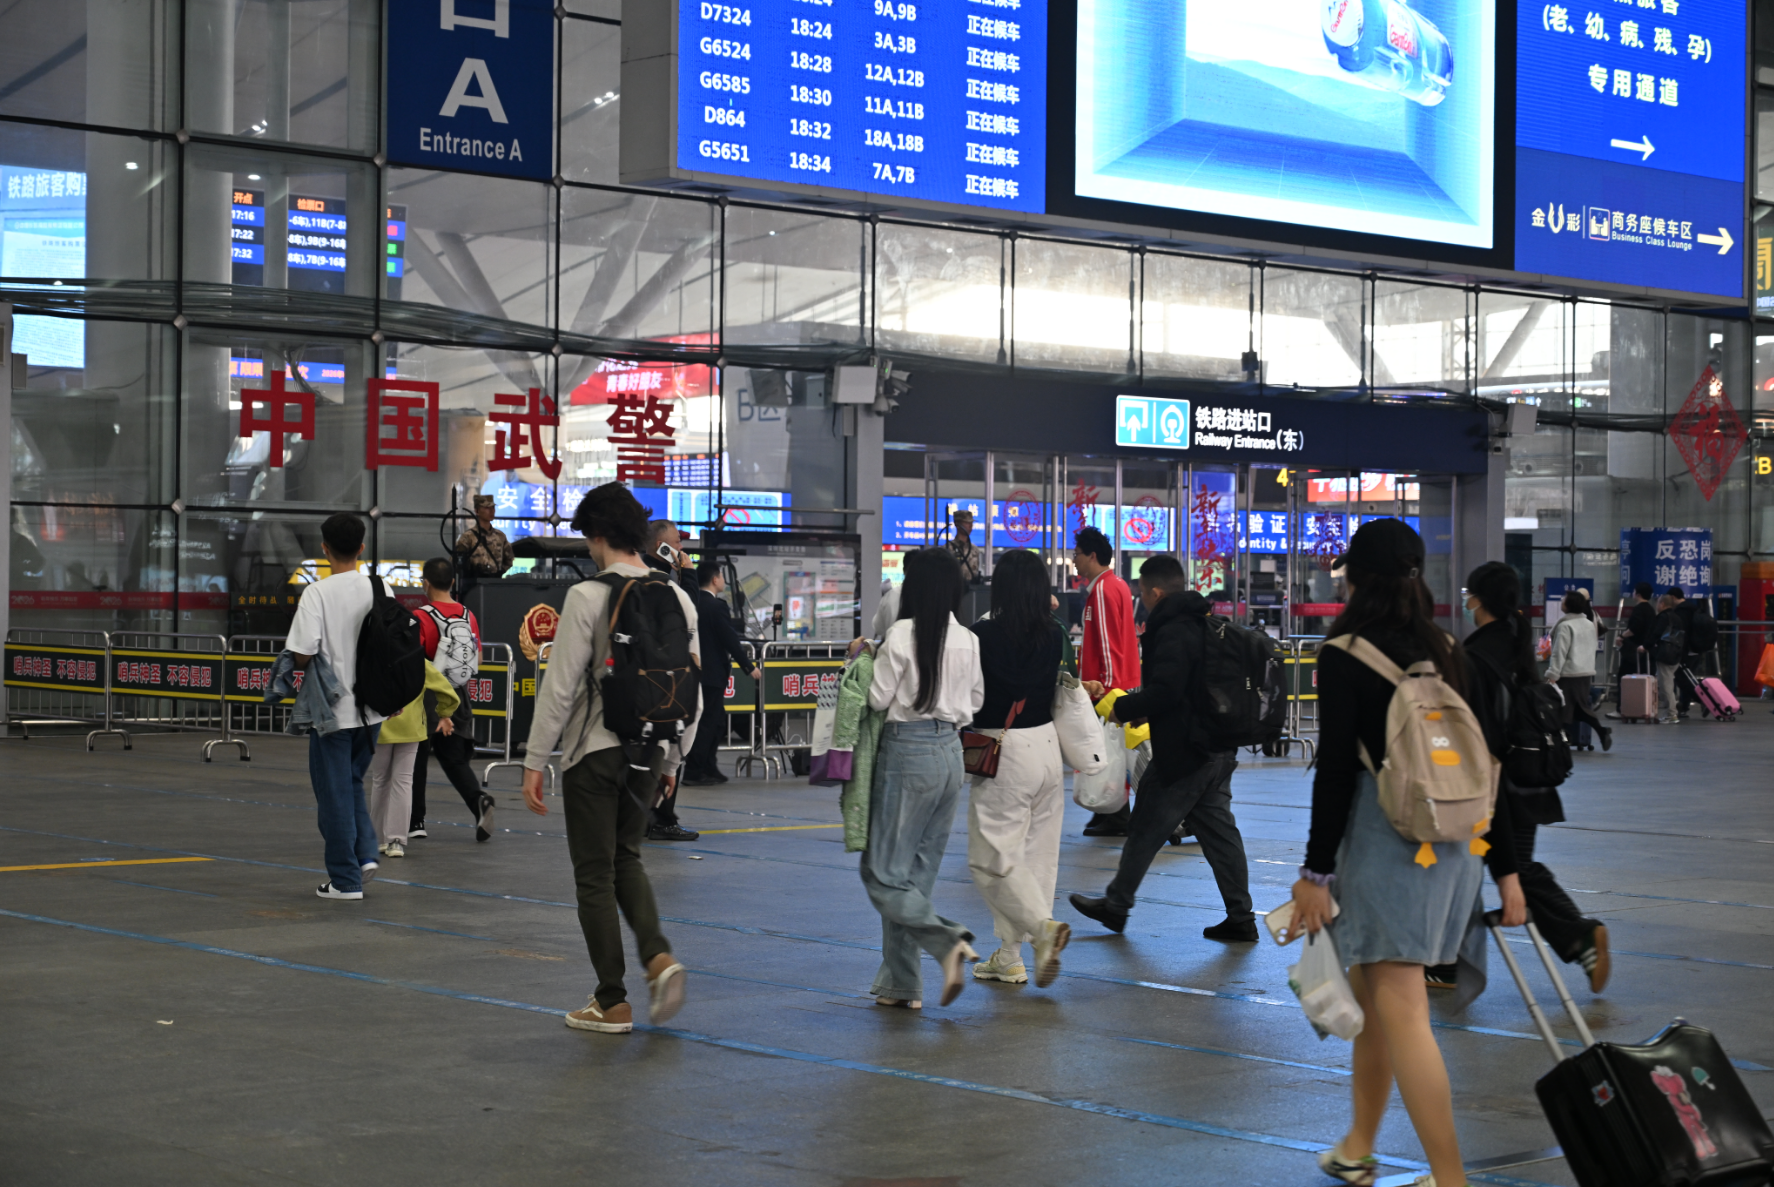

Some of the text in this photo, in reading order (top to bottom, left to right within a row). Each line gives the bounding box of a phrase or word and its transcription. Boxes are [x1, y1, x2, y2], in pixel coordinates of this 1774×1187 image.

[701, 2, 1020, 73] D7324 18:24 3A,3B 正在候车
[874, 0, 1021, 41] 9A,9B 正在候车
[438, 57, 509, 124] A
[700, 37, 1020, 105] G6524 18:28 12A,12B 正在候车
[1588, 63, 1679, 107] 专用通道
[700, 71, 1020, 136] G6585 18:30 11A,11B 正在候车
[420, 127, 523, 162] Entrance A
[704, 105, 1020, 168] D864 18:32 18A,18B 正在候车
[699, 140, 1019, 199] G5651 18:34 7A,7B 正在候车
[1612, 211, 1693, 240] 商务座候车区
[1612, 231, 1692, 251] Business Class Lounge
[239, 370, 676, 484] 中国武警
[1195, 406, 1271, 432] 铁路进站口
[1276, 428, 1304, 451] (东)
[1195, 432, 1276, 450] Railway Entrance
[13, 656, 97, 681] 哨兵神圣 不容侵犯
[117, 662, 212, 687] 哨兵神圣 不容侵犯
